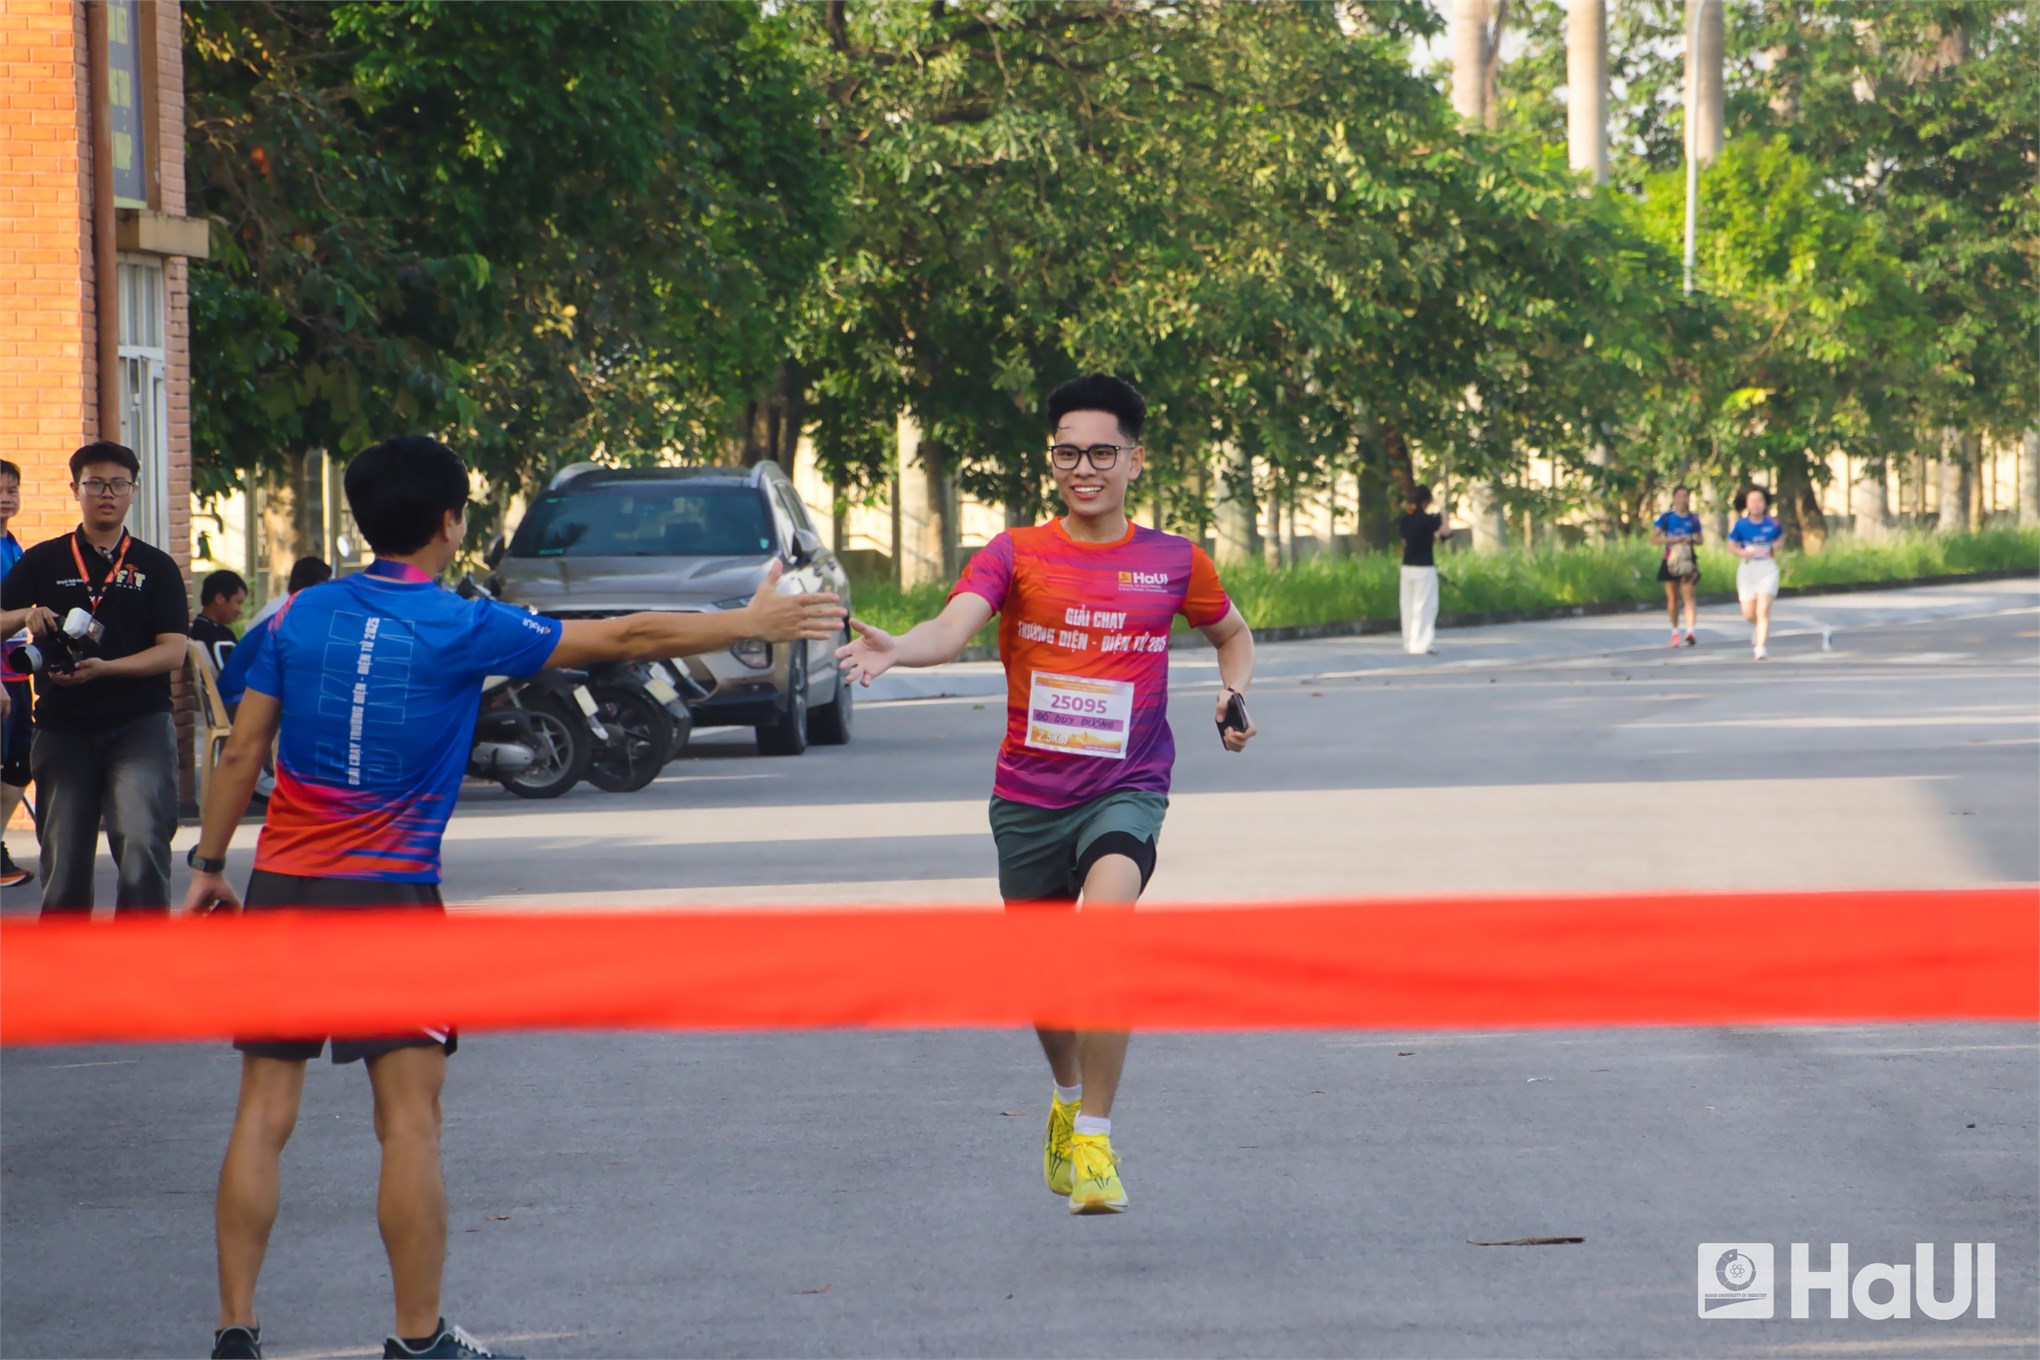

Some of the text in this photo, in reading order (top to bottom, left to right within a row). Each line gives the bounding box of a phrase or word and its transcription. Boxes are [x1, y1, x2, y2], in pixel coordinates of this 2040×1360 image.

[363, 616, 380, 640] 2025
[1093, 611, 1127, 633] CHẠY
[1050, 693, 1108, 714] 25095
